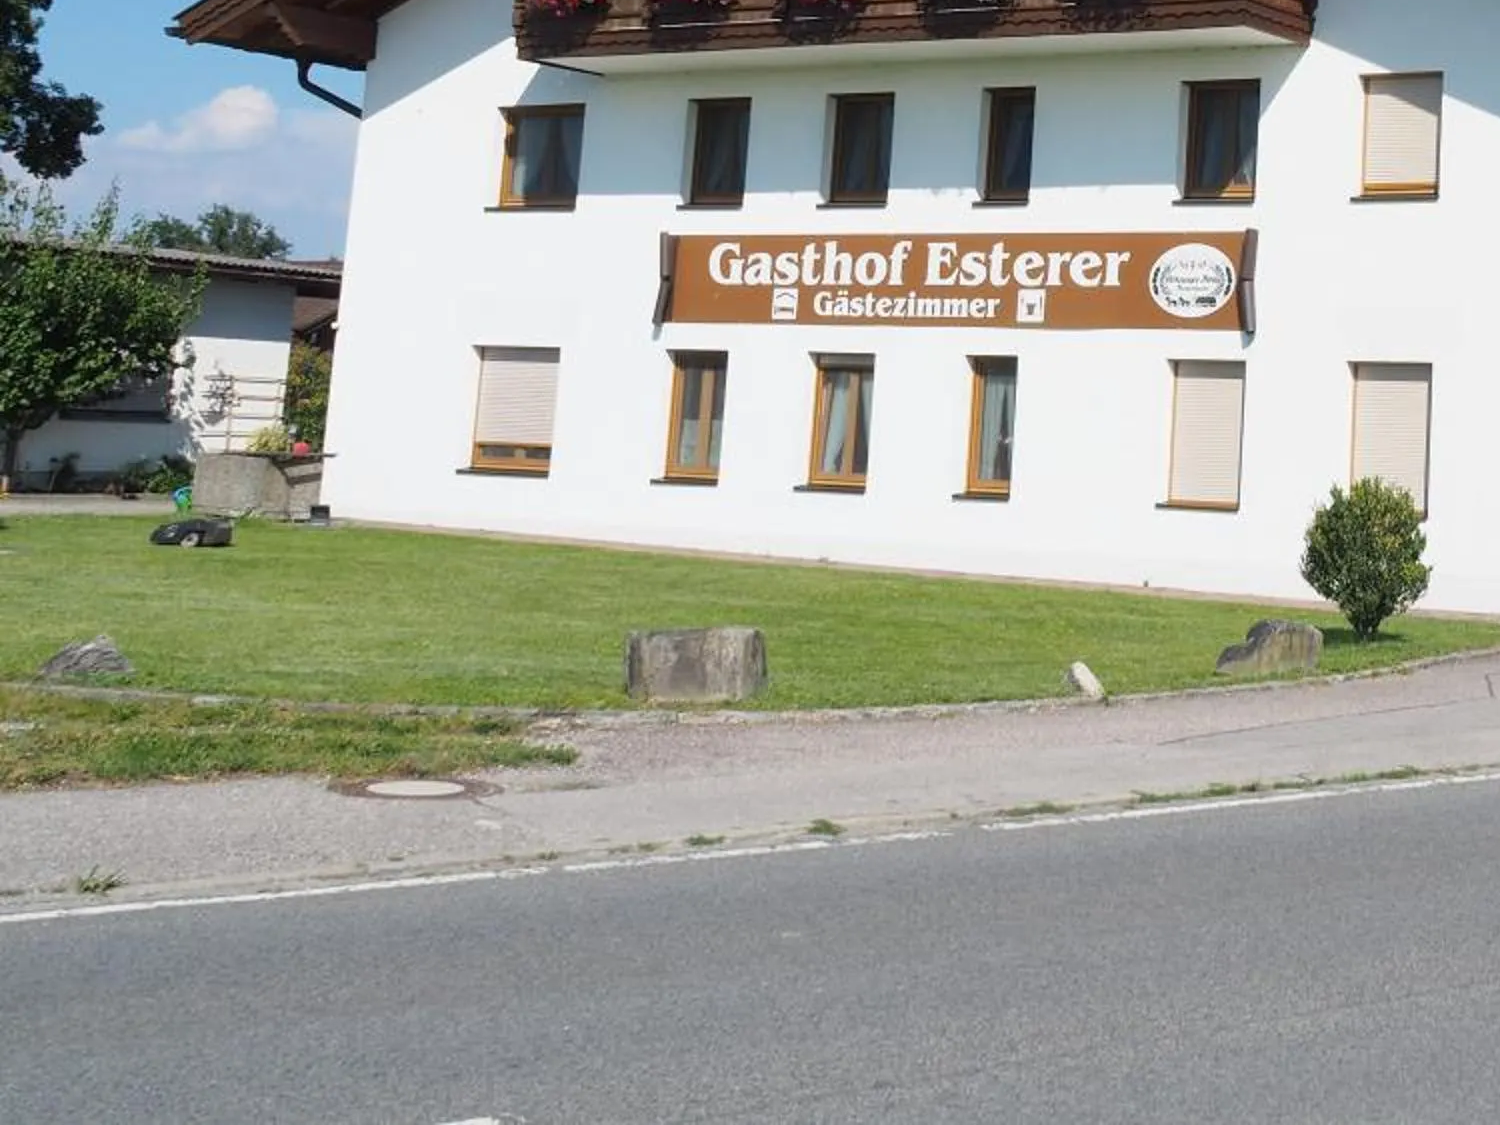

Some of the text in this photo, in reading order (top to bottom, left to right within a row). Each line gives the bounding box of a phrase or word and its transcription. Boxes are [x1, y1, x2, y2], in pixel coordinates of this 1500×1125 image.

[708, 240, 1131, 287] Gasthof Esterer
[813, 290, 1000, 318] Gästezimmer
